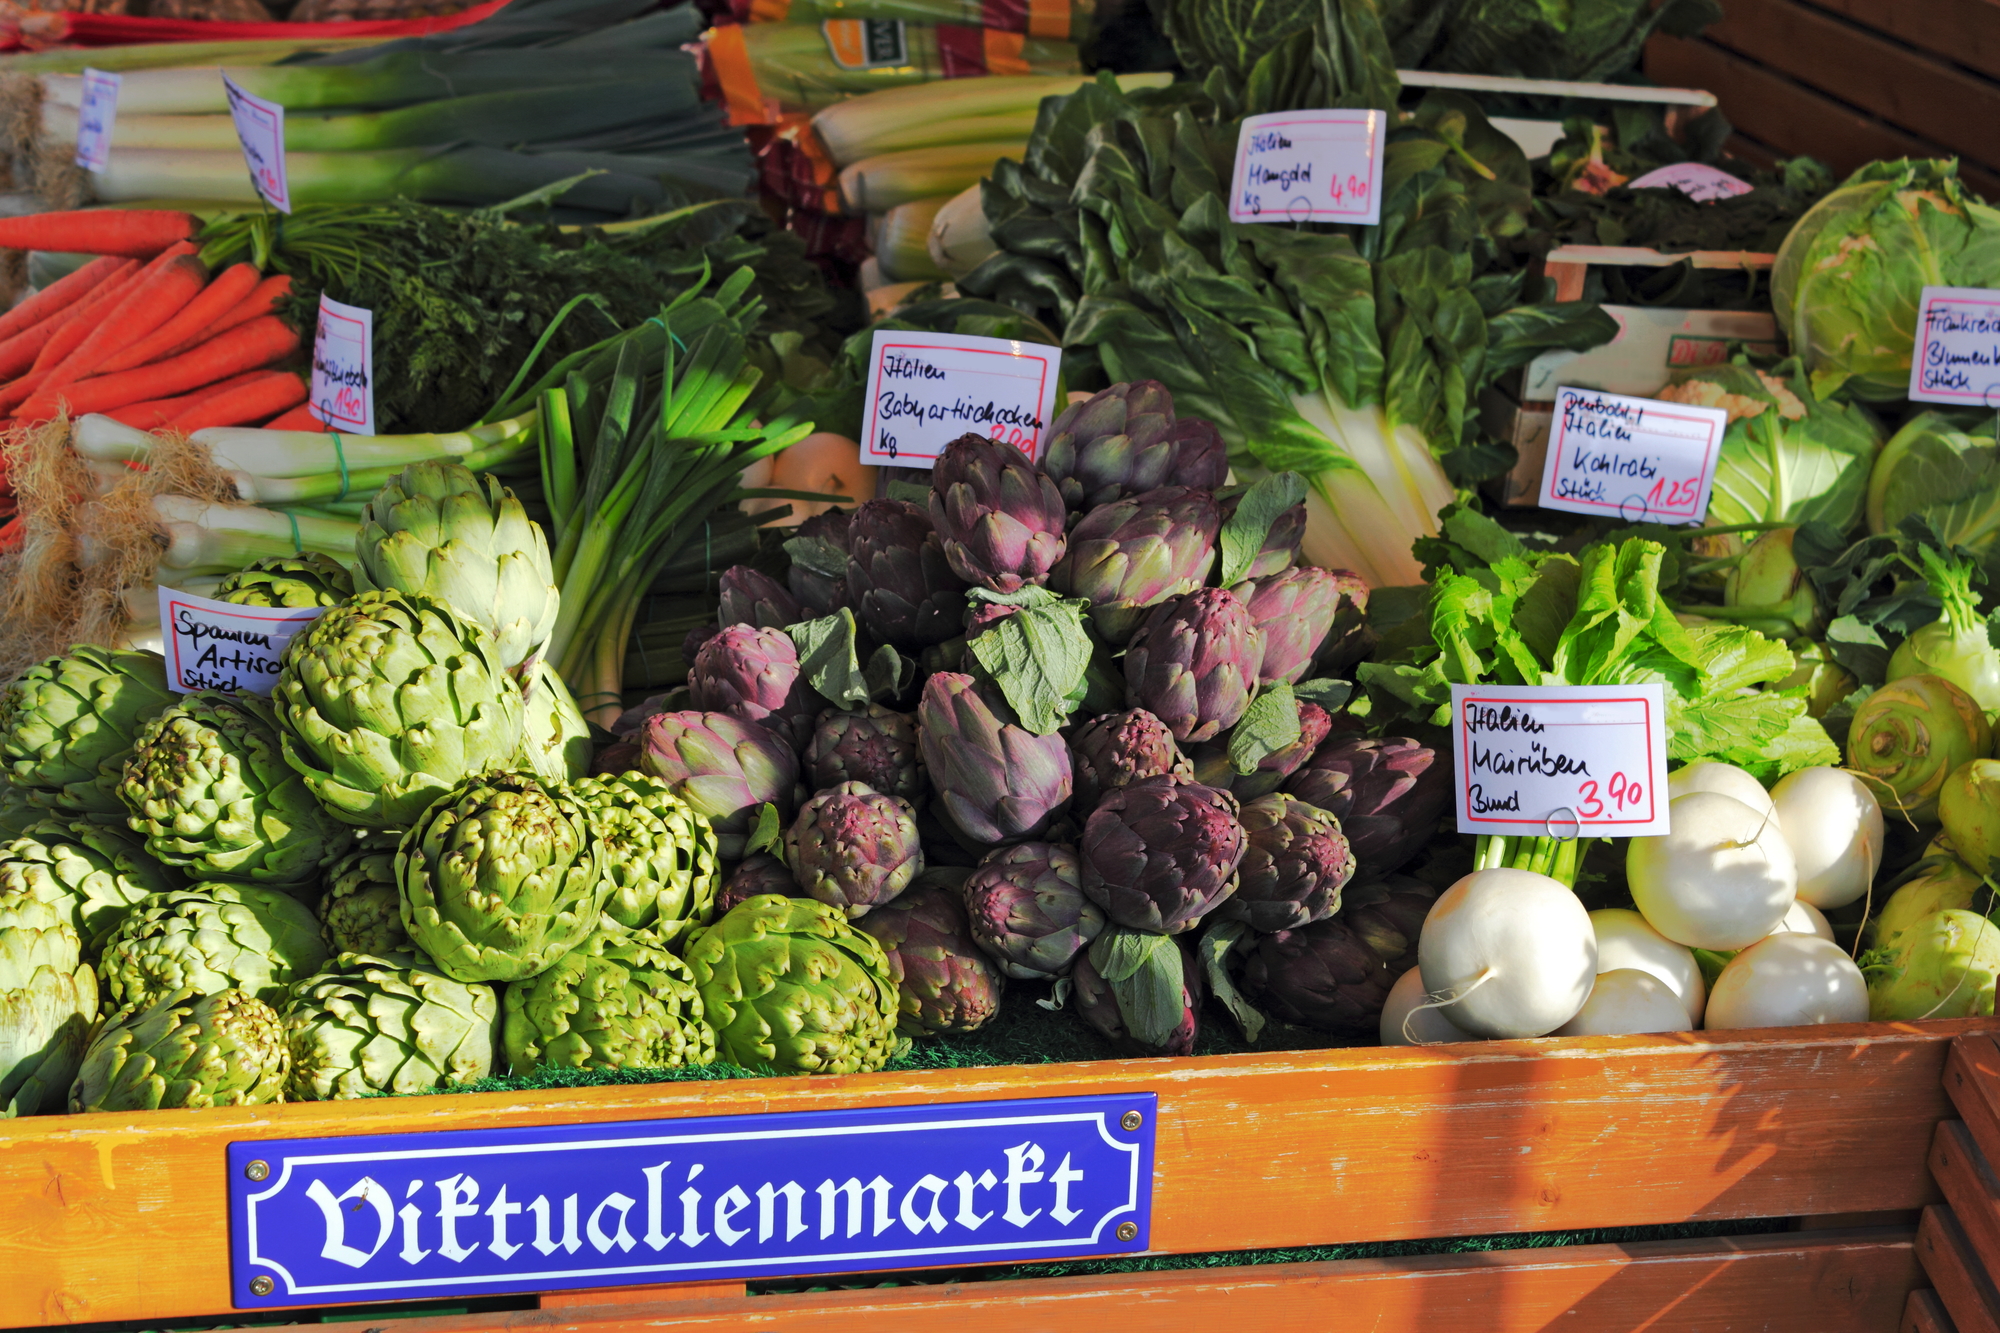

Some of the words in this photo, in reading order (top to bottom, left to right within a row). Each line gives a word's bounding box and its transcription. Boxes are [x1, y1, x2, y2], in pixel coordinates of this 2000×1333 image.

[1248, 163, 1311, 191] Mangold
[1330, 174, 1366, 208] 4.90
[882, 355, 945, 380] Italien
[1564, 412, 1631, 442] Italien
[1647, 477, 1699, 508] 1.25
[196, 644, 284, 675] Artisc
[1465, 703, 1545, 734] Italien
[1473, 740, 1591, 777] Mairüben
[1469, 784, 1520, 813] Bund
[1576, 771, 1642, 819] 3.90
[304, 1141, 1084, 1268] Viktualienmarkt
